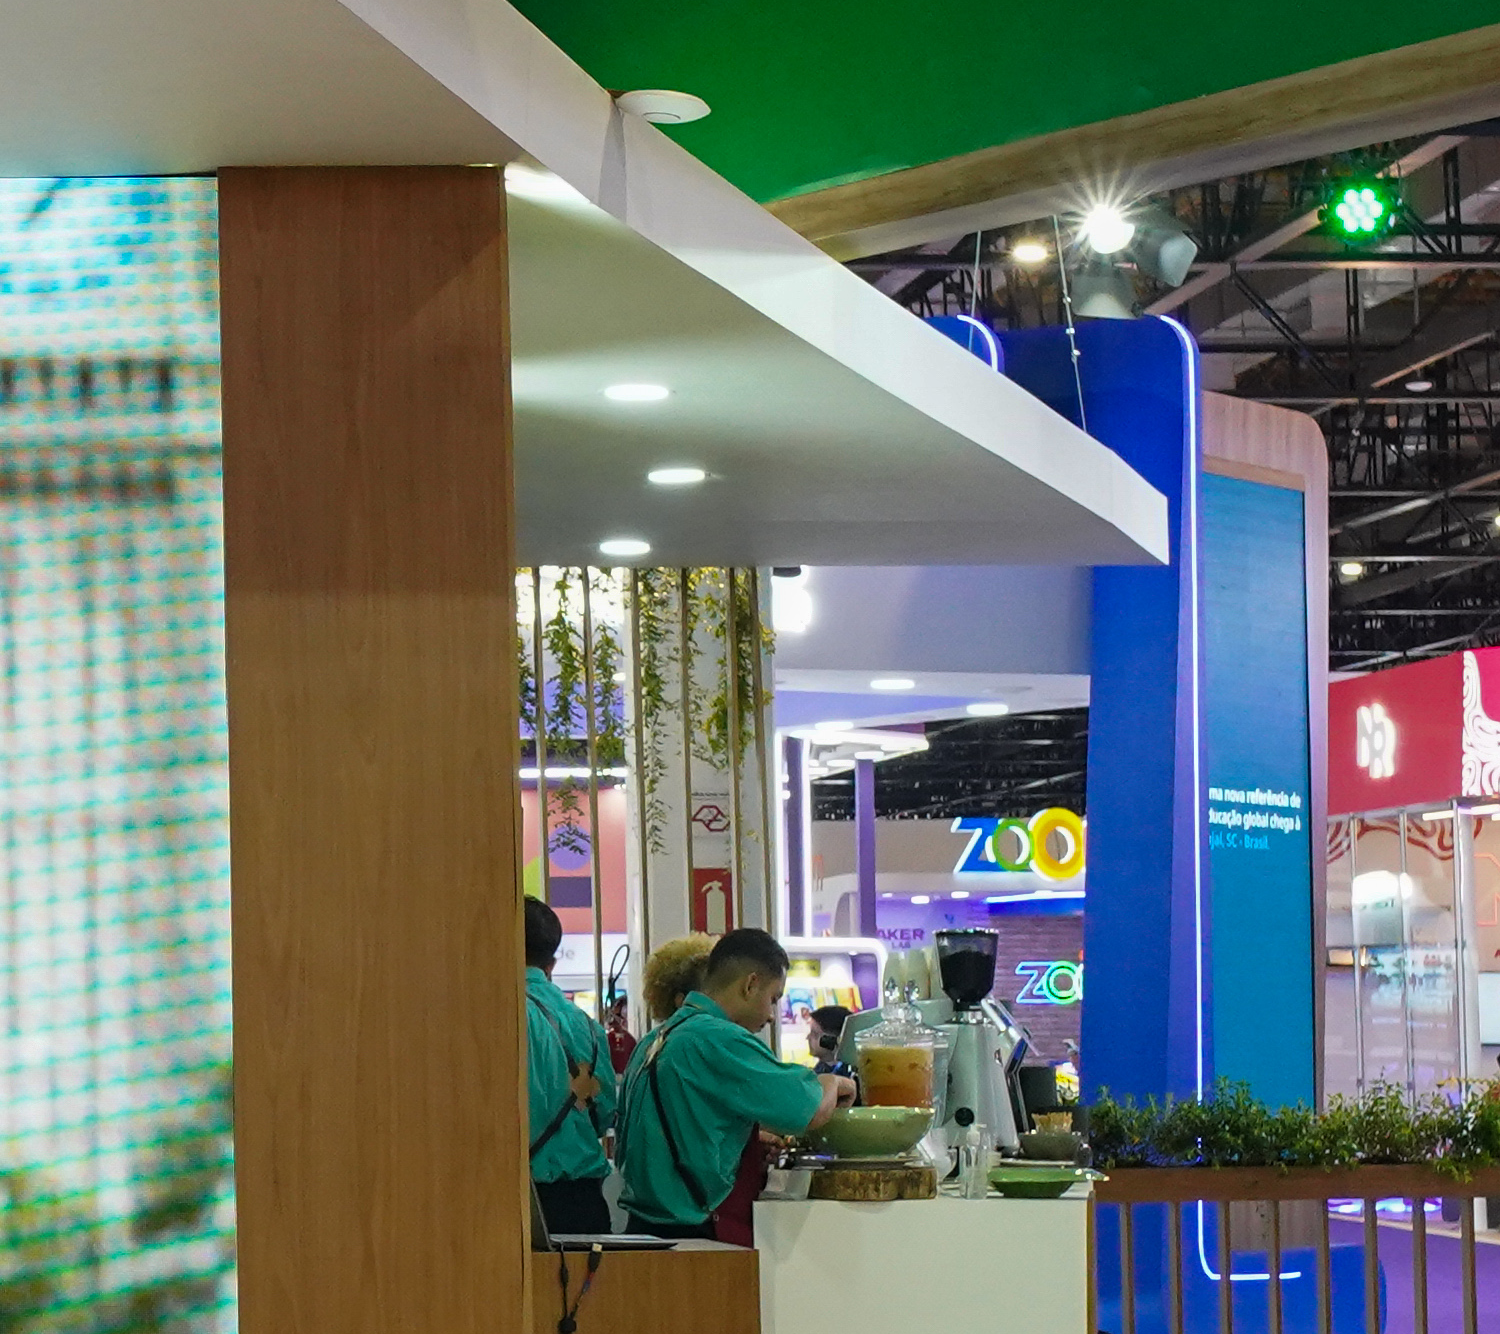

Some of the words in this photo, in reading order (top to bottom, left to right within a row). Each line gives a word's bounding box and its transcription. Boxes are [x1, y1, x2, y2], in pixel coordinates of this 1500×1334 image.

[1224, 788, 1245, 803] nova
[1246, 788, 1289, 807] referência
[1290, 791, 1301, 808] de
[1243, 810, 1269, 830] global
[1269, 813, 1294, 834] chega
[951, 807, 1087, 881] ZOO
[1016, 960, 1083, 1005] ZO
